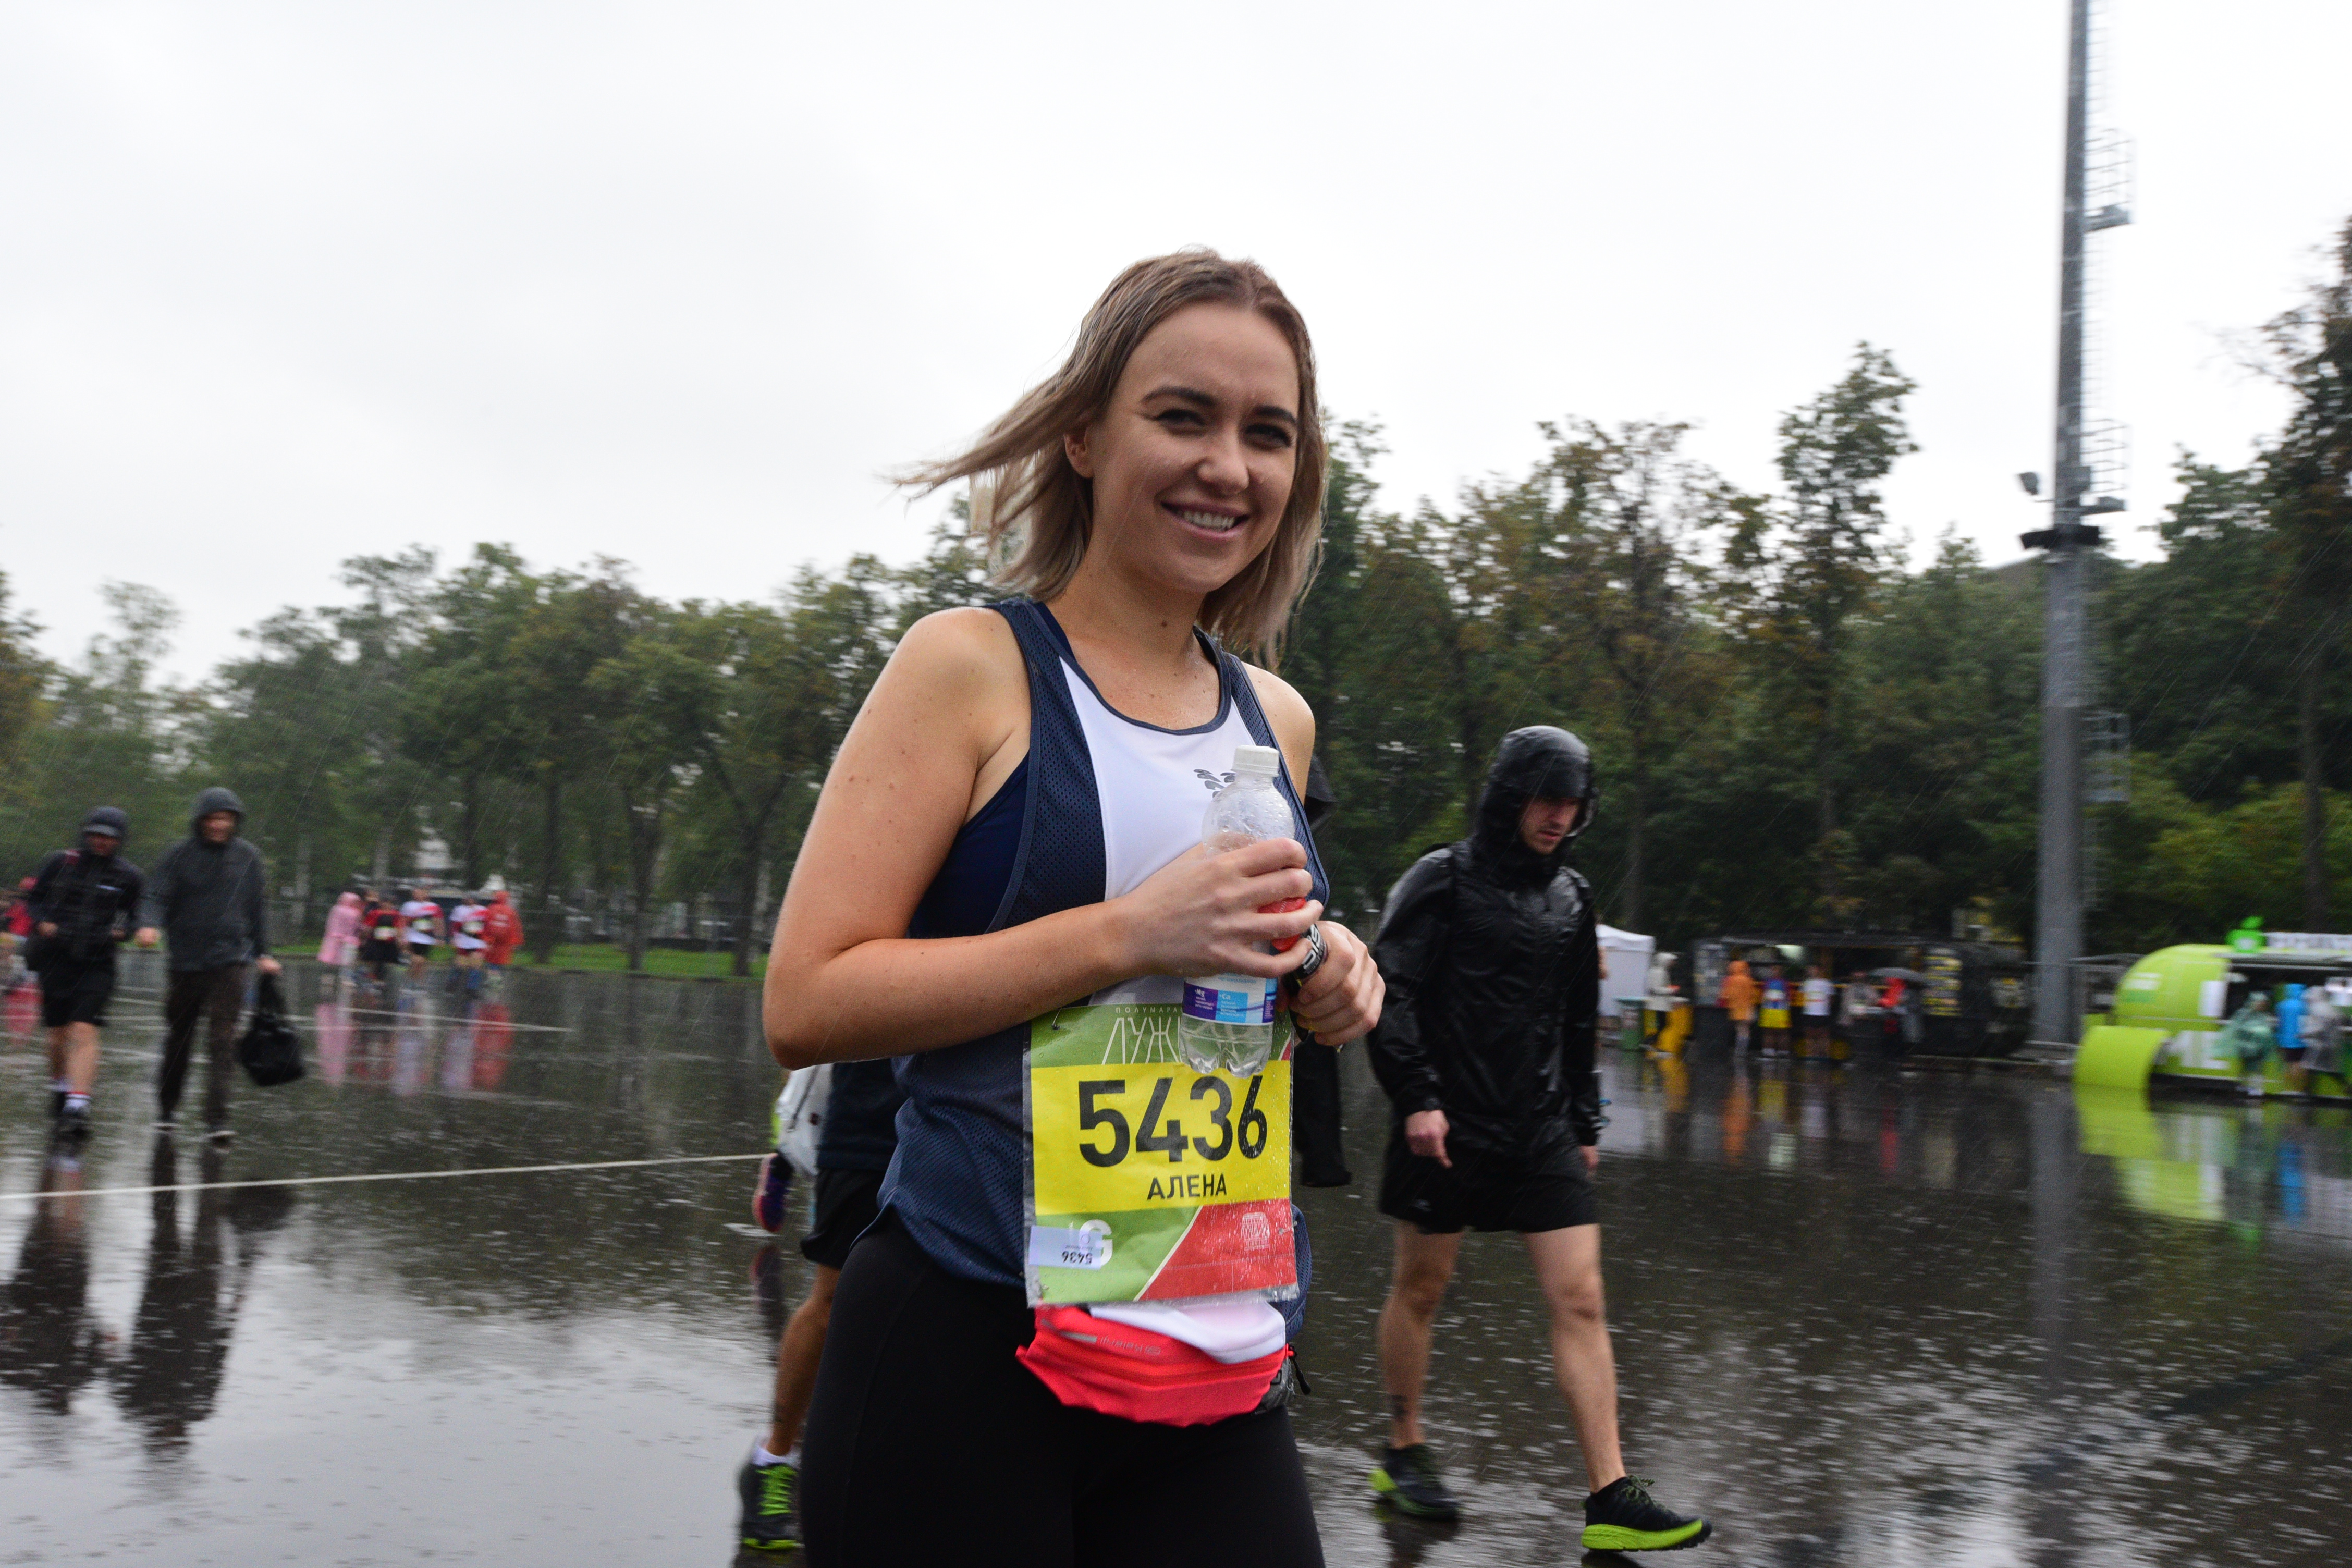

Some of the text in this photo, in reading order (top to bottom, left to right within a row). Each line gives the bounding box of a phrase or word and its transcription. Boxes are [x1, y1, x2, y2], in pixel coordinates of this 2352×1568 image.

[1079, 1075, 1267, 1167] 5436
[1147, 1173, 1227, 1200] АЛЕНА
[1062, 1251, 1093, 1264] 5436
